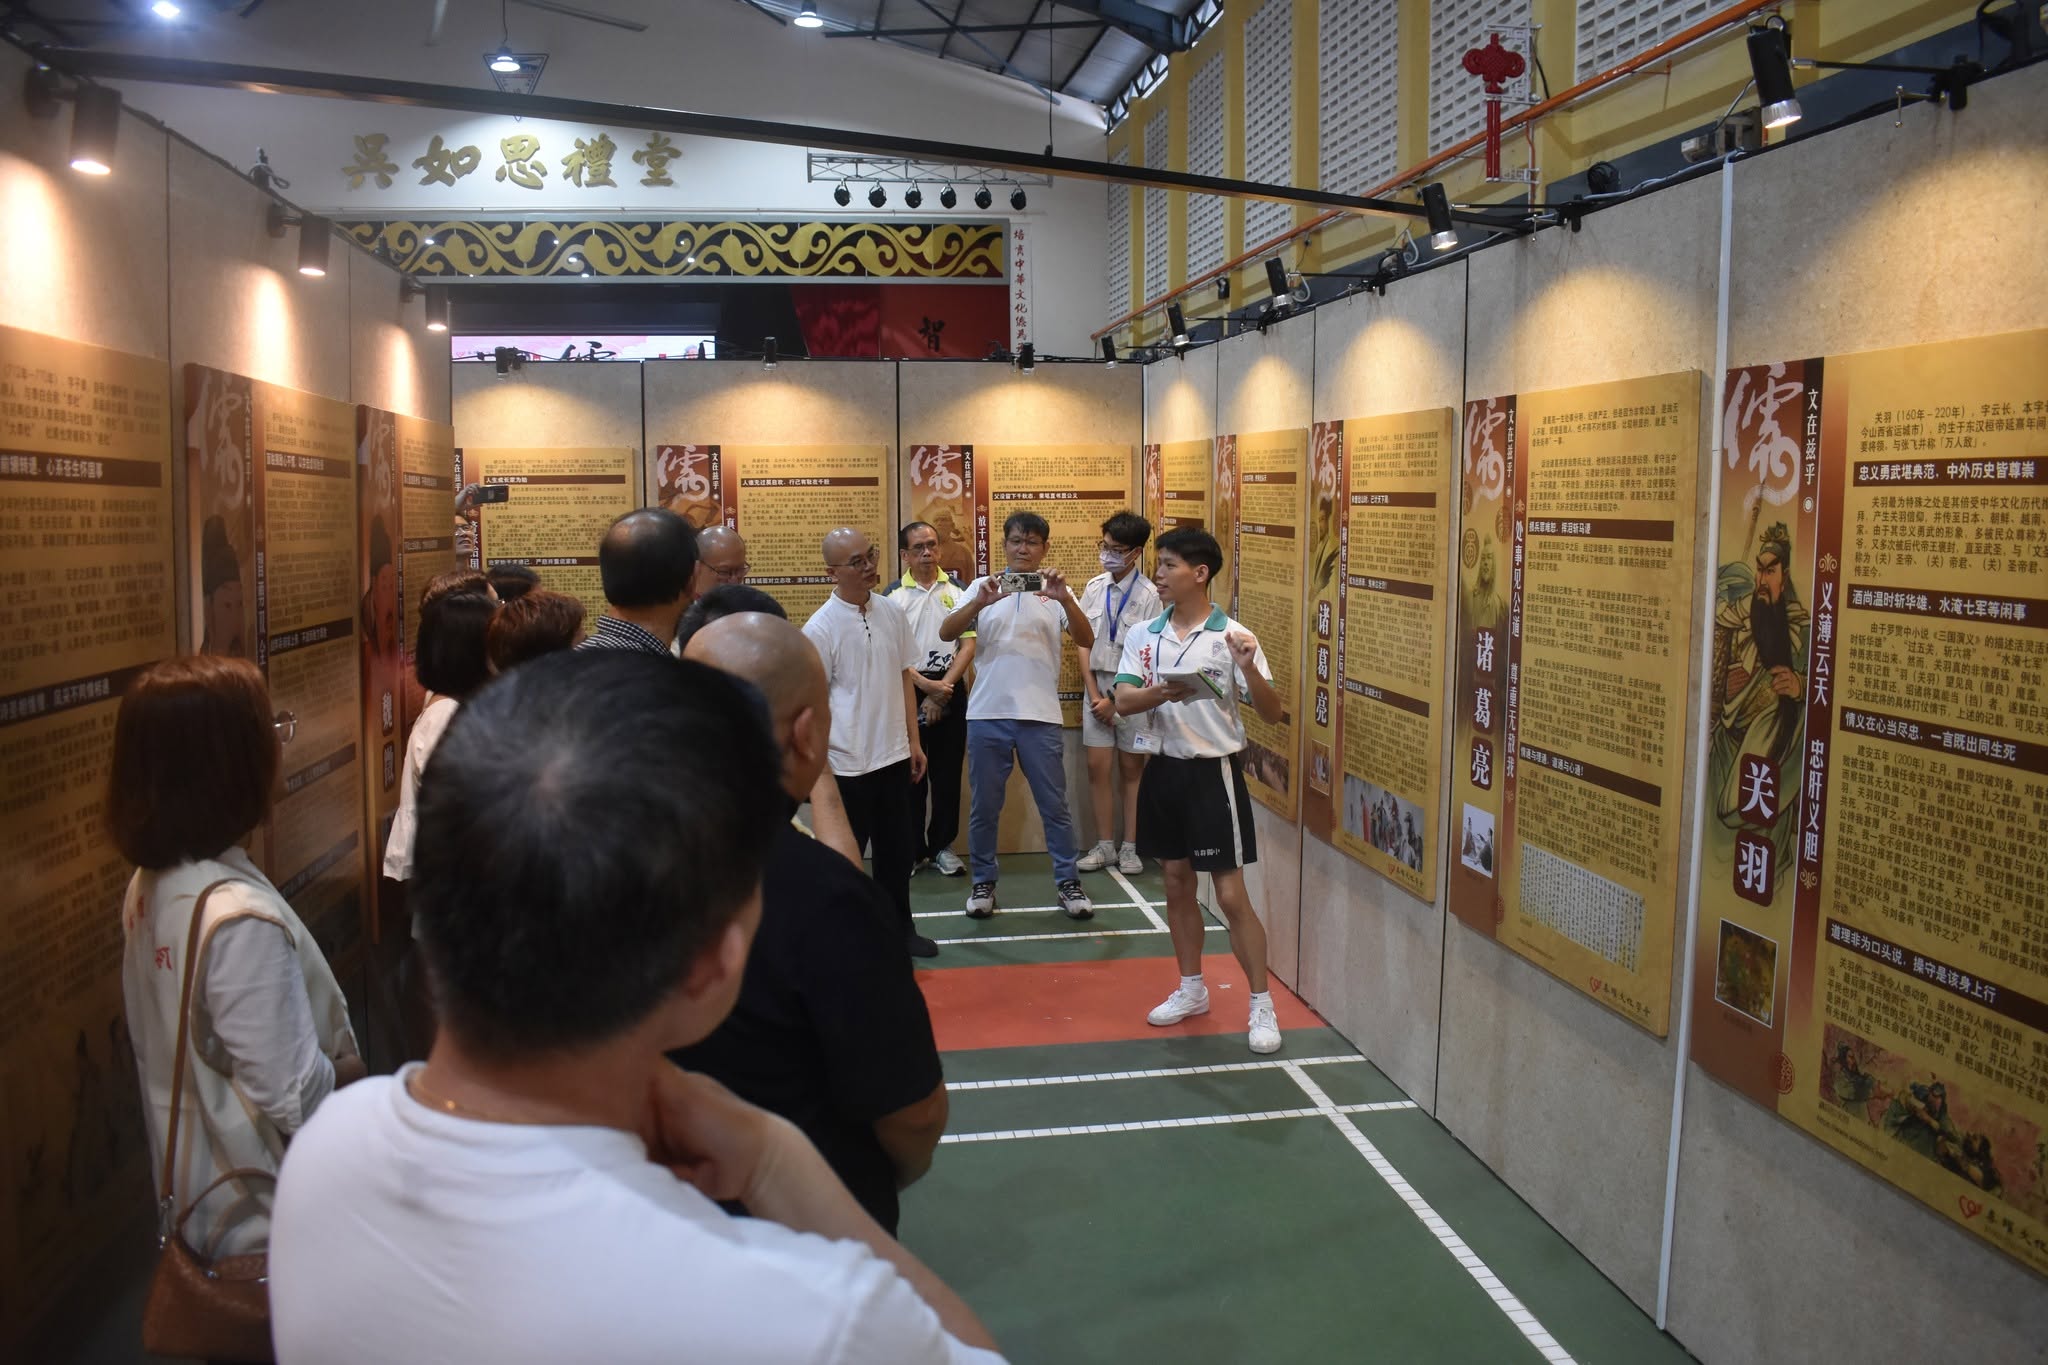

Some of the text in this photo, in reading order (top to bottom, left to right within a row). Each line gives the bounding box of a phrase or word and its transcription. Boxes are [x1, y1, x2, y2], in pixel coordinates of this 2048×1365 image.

[341, 132, 683, 191] 吳如思禮堂
[1472, 631, 1494, 786] 诸葛亮
[1803, 581, 1834, 864] 义薄云天 忠肝义胆
[1738, 761, 1775, 896] 关羽
